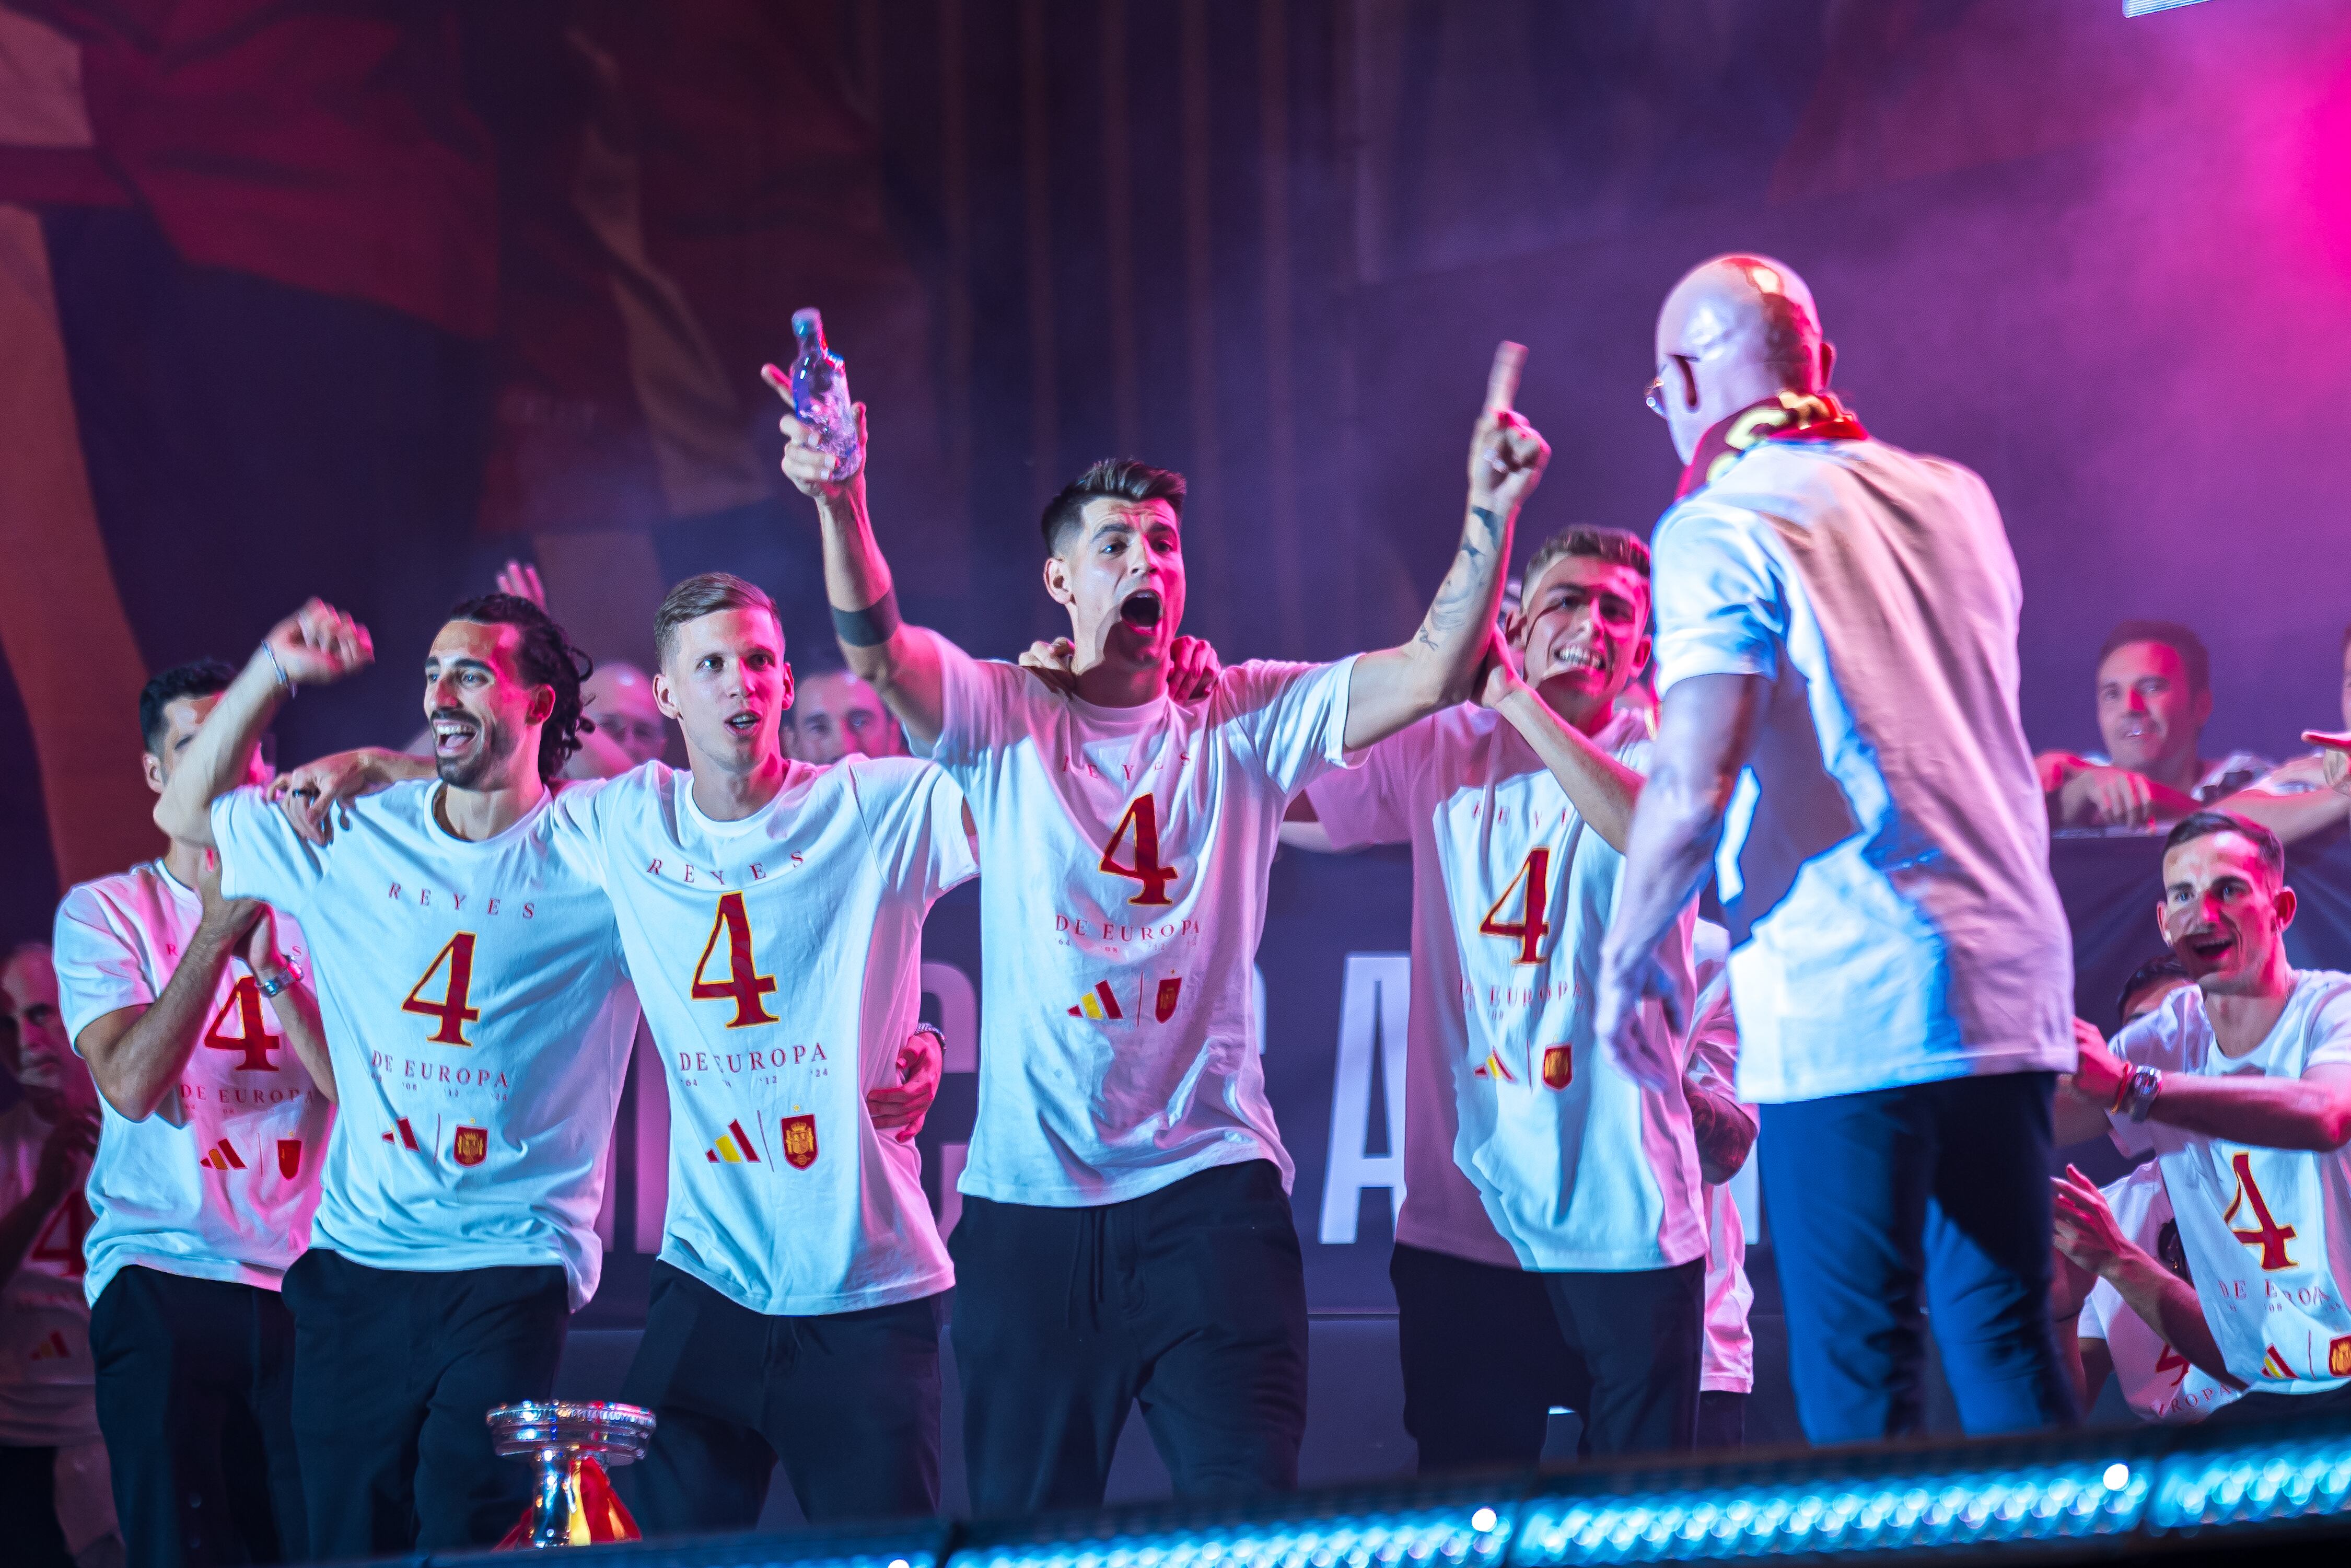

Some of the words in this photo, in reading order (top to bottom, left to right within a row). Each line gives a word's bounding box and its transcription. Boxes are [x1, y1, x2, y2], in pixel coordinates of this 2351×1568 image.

[647, 850, 805, 886] REYES
[1098, 792, 1178, 906] 4
[388, 881, 536, 920] REYES
[1055, 914, 1087, 936] DE
[1480, 846, 1550, 966] 4
[401, 930, 481, 1048] 4
[690, 890, 781, 1031] 4
[204, 974, 281, 1072] 4
[180, 1084, 206, 1100] DE
[219, 1089, 314, 1104] EUROPA
[371, 1050, 393, 1073] DE
[404, 1058, 509, 1089] EUROPA
[680, 1052, 708, 1071] DE
[2224, 1151, 2300, 1272] 4
